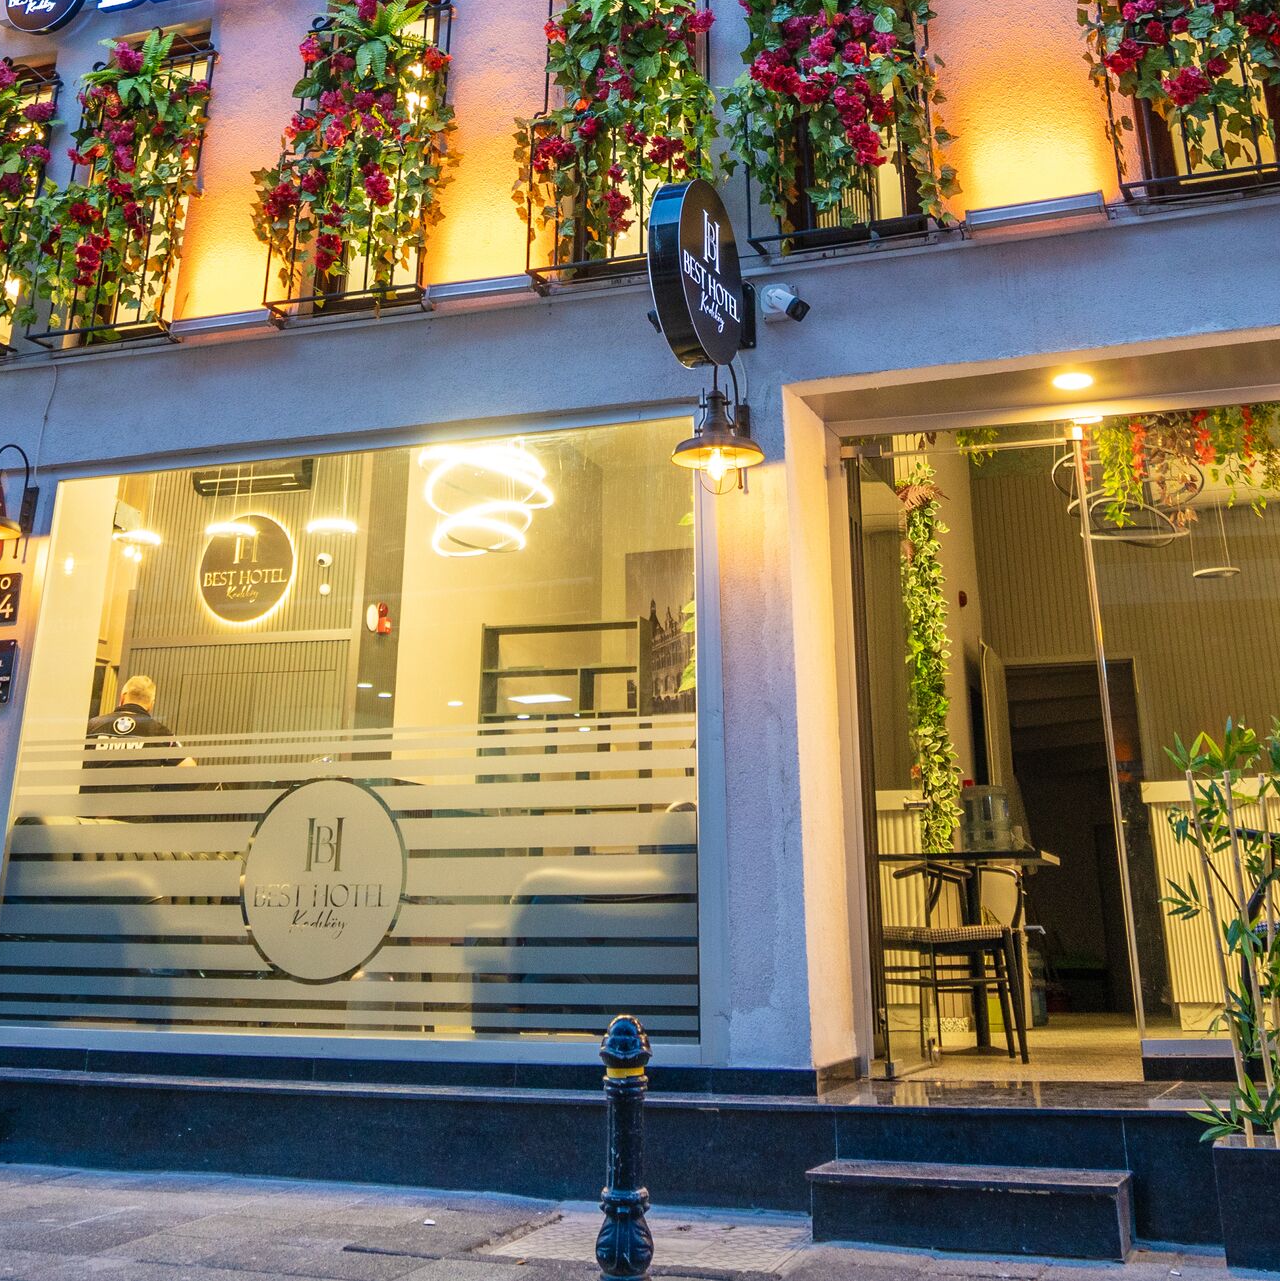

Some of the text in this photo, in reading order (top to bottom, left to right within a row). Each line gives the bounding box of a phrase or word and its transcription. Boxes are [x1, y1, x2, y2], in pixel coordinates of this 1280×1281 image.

[683, 249, 740, 323] BEST HOTEL
[203, 568, 287, 587] BEST HOTEL
[254, 883, 390, 908] BEST HOTEL
